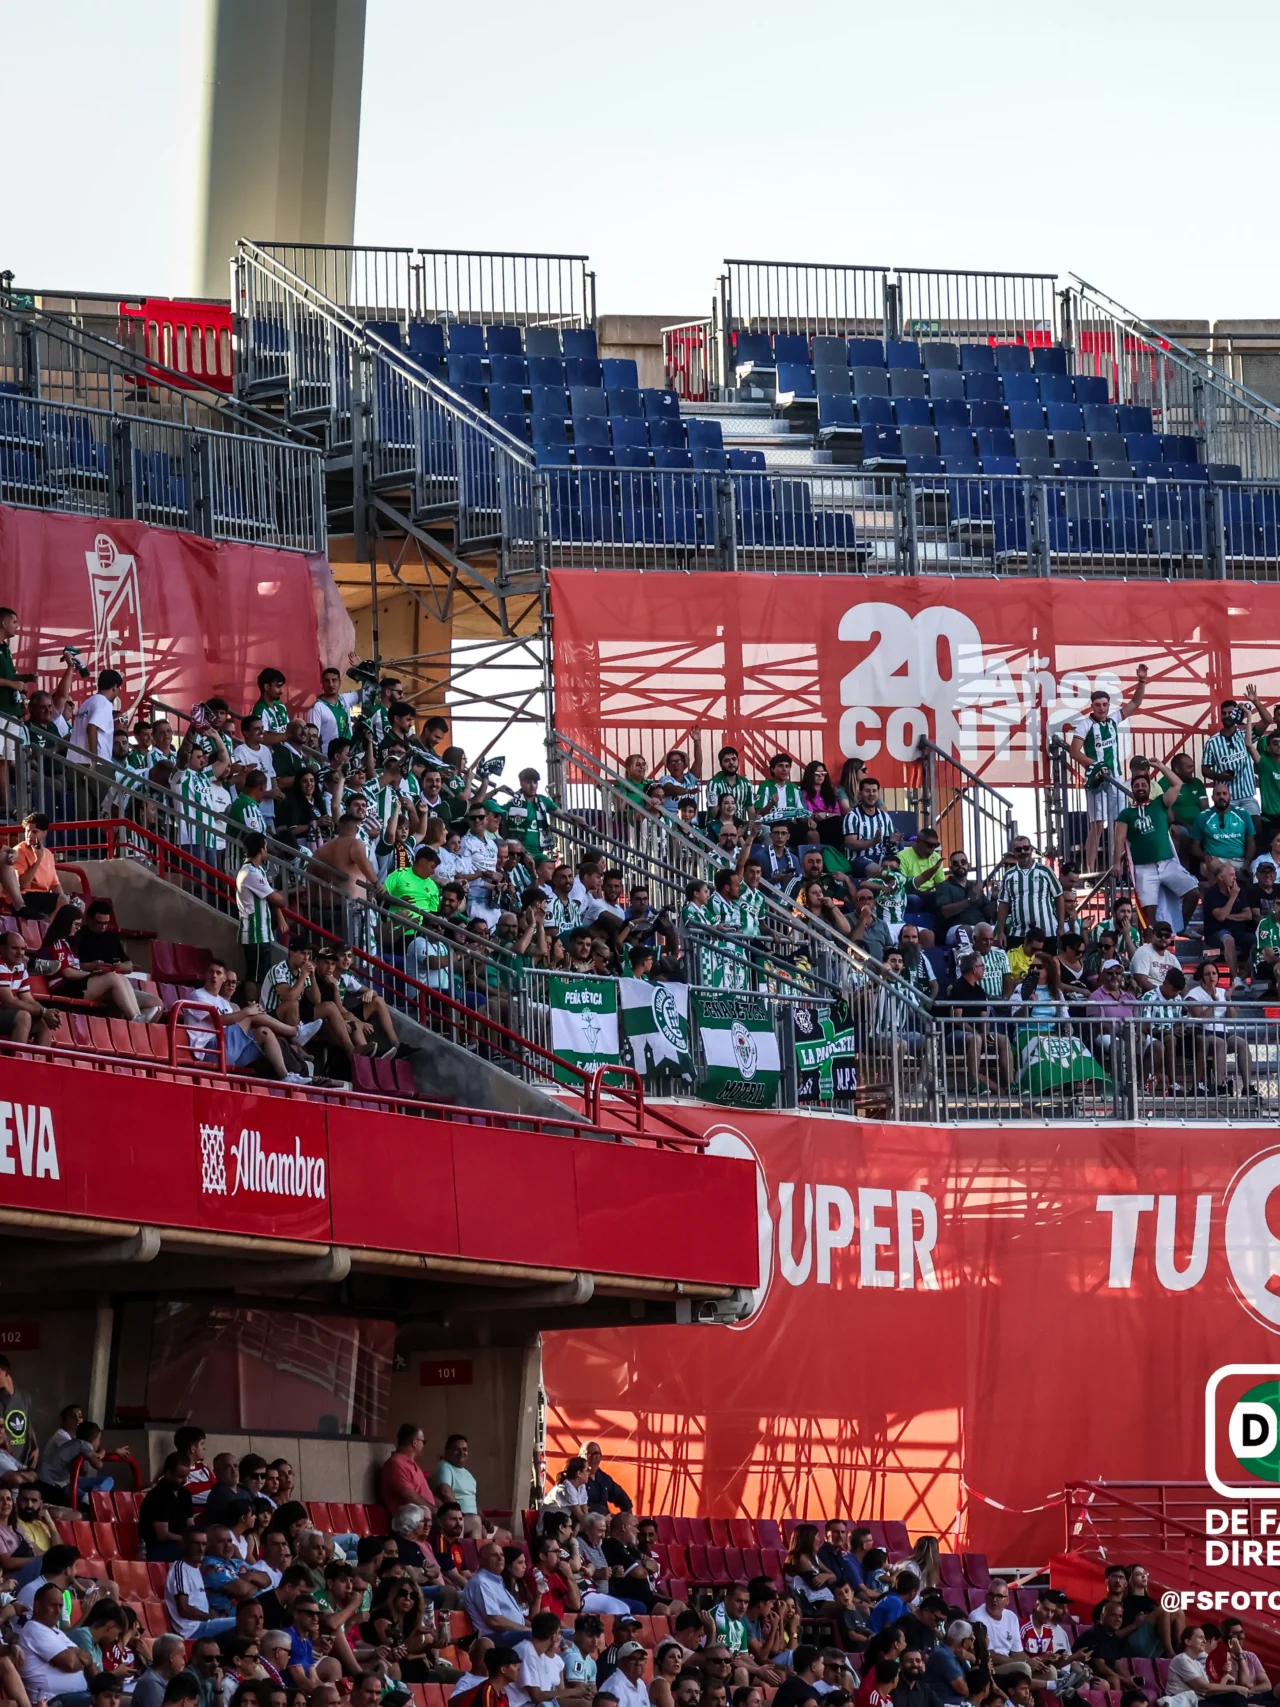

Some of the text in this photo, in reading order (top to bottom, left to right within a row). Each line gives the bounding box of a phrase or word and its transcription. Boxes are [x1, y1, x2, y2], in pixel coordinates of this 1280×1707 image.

[838, 602, 982, 706] 20
[717, 1079, 766, 1104] MOTRIL
[801, 1048, 815, 1065] LA
[230, 1127, 326, 1199] Alhambra
[778, 1182, 940, 1290] UPER
[1096, 1193, 1213, 1291] TU
[438, 1368, 455, 1378] 101
